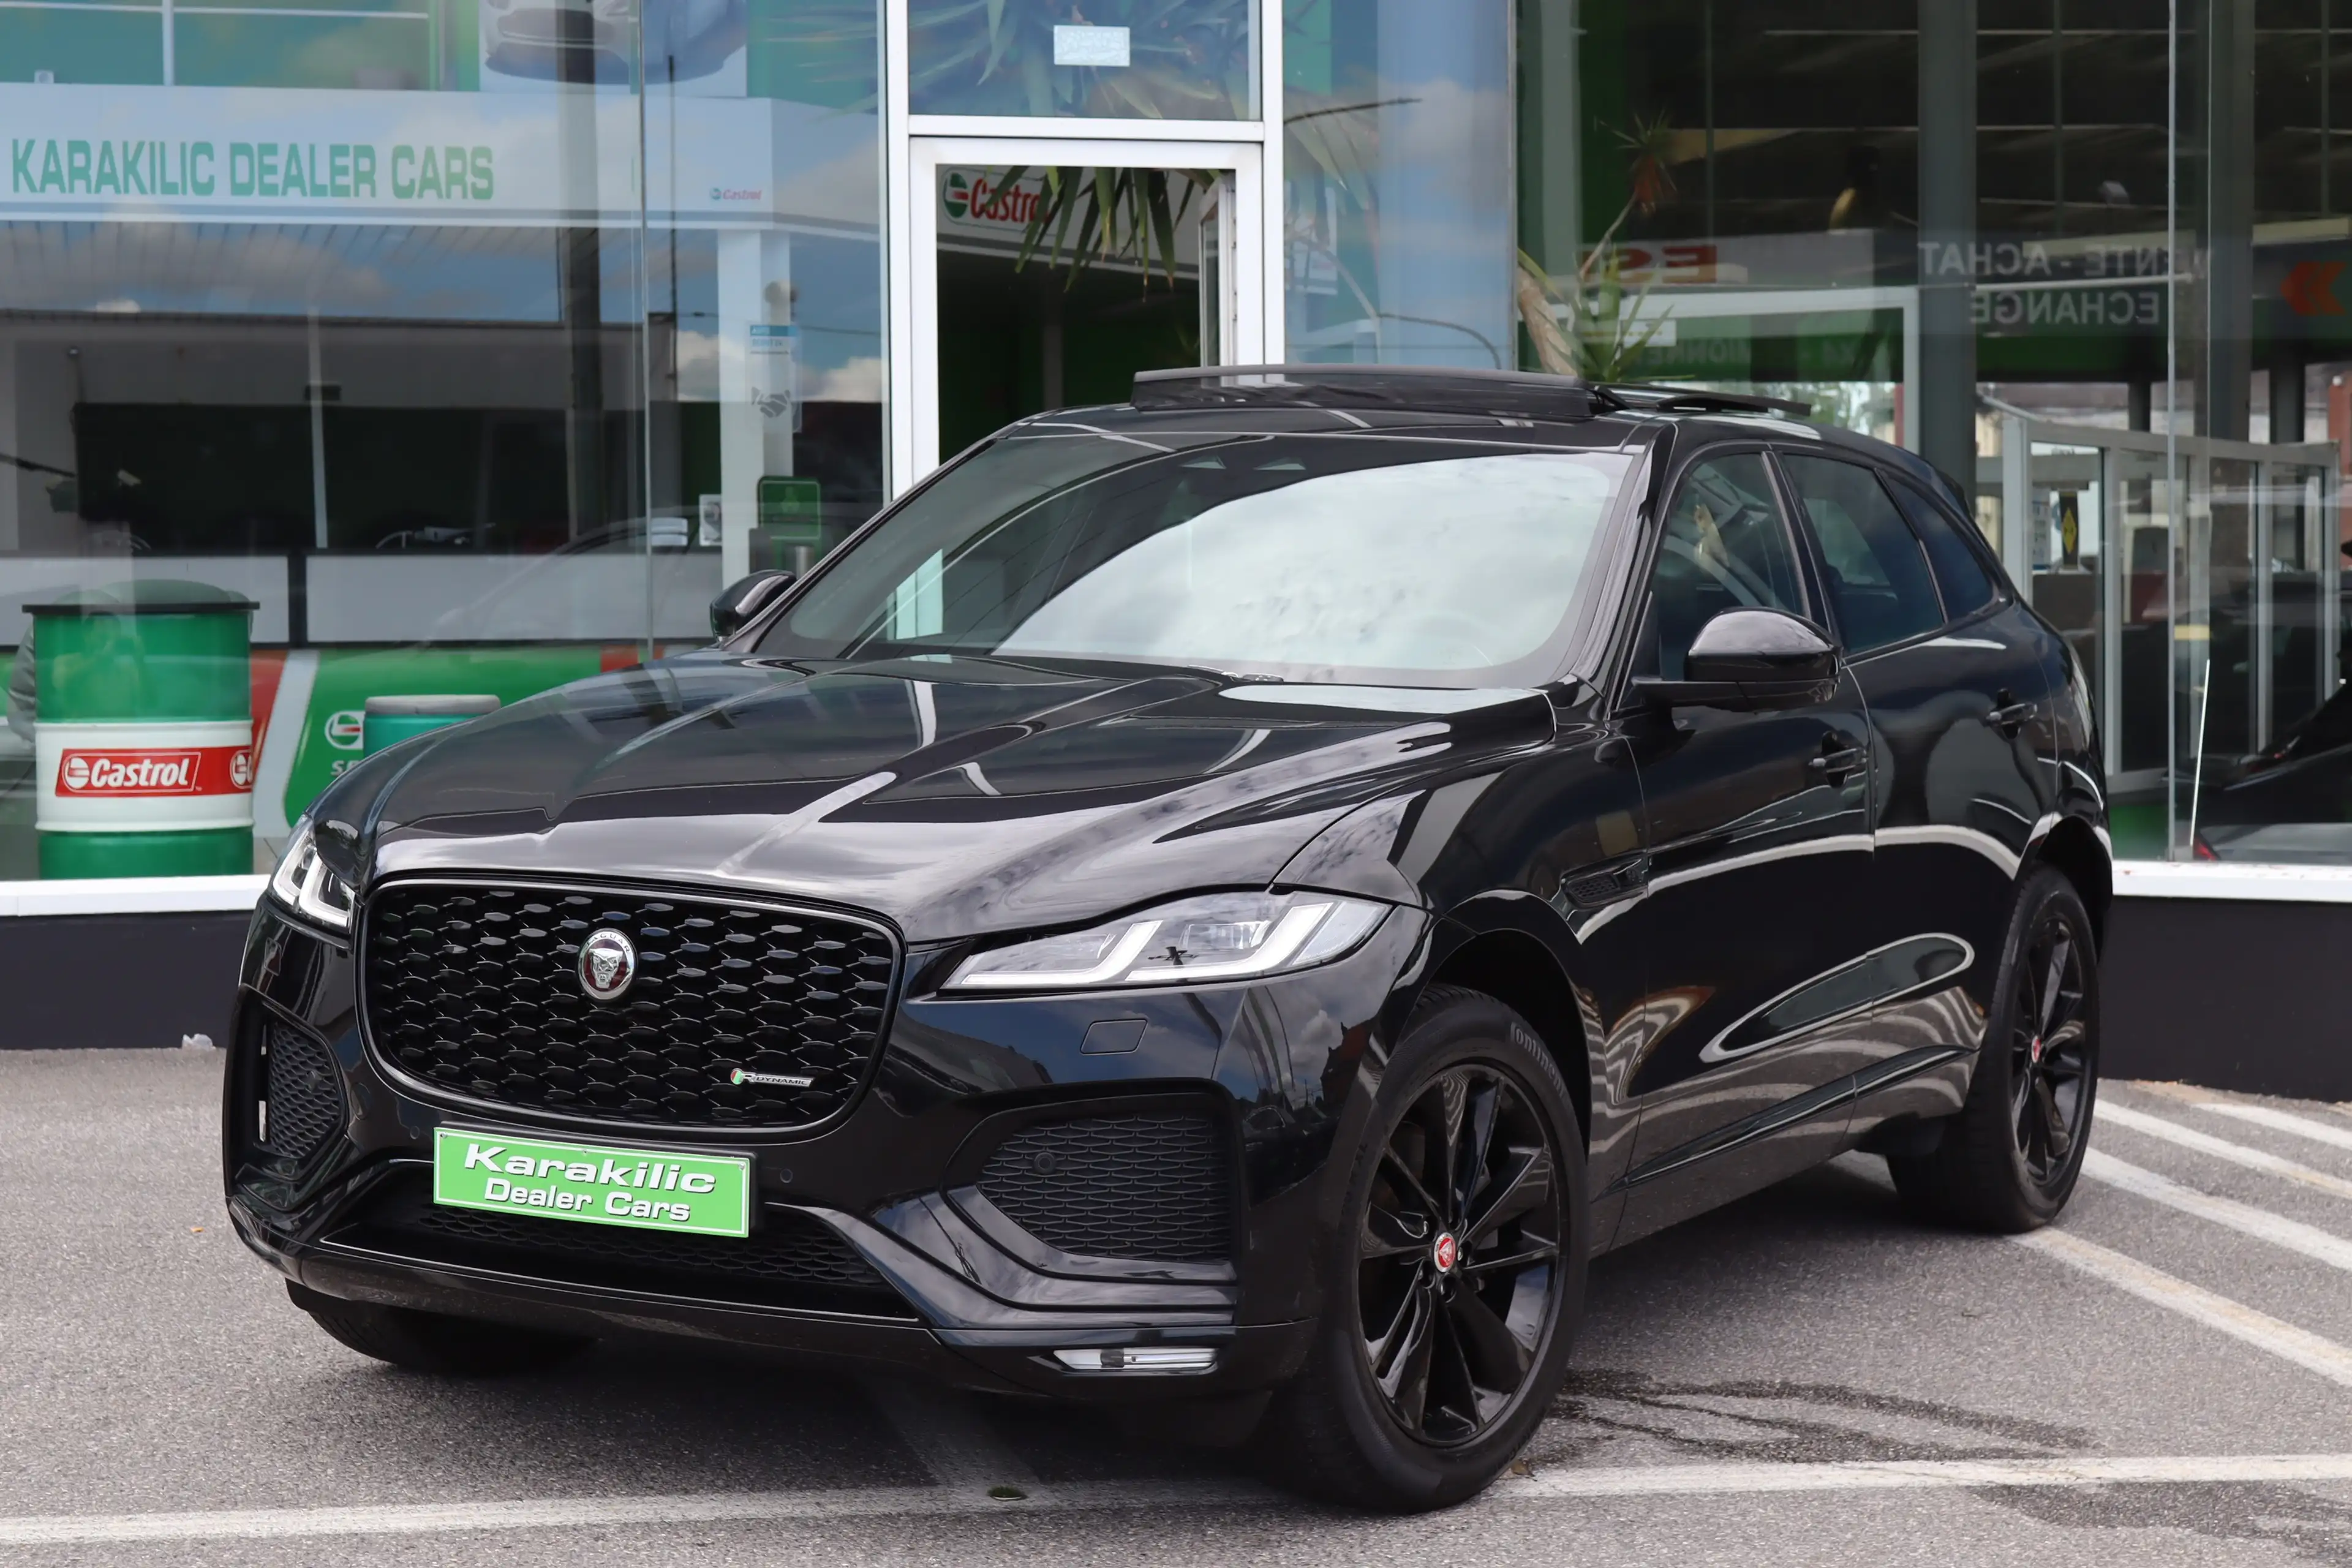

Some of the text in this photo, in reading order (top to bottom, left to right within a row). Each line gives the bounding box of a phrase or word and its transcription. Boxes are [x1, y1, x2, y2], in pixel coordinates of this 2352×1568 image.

[12, 138, 494, 200] KARAKILIC DEALER CARS
[91, 757, 190, 788] Castrol
[586, 933, 630, 952] JAGUAR
[756, 1076, 809, 1085] DYNAMIC
[464, 1143, 717, 1194] Karakilic
[484, 1177, 692, 1222] Dealer Cars
